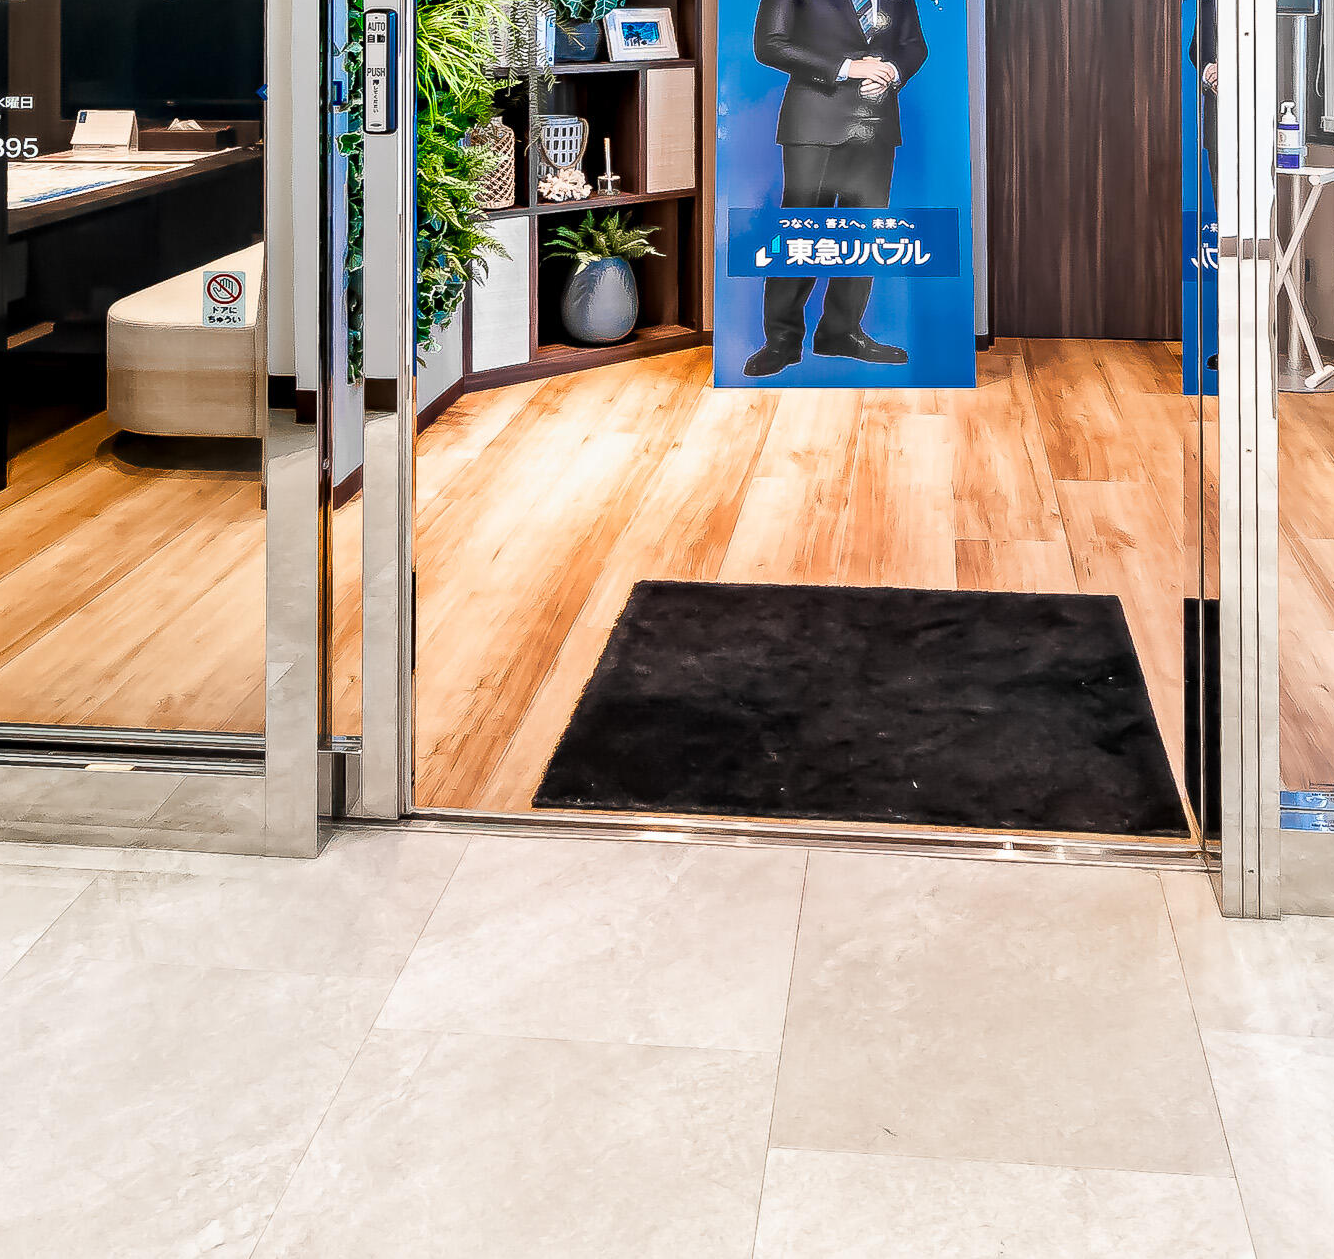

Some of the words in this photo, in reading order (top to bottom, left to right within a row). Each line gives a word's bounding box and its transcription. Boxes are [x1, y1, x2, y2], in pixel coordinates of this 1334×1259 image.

[367, 21, 386, 32] AUTO
[367, 67, 386, 77] PUSH
[786, 238, 931, 265] 東急リバブル
